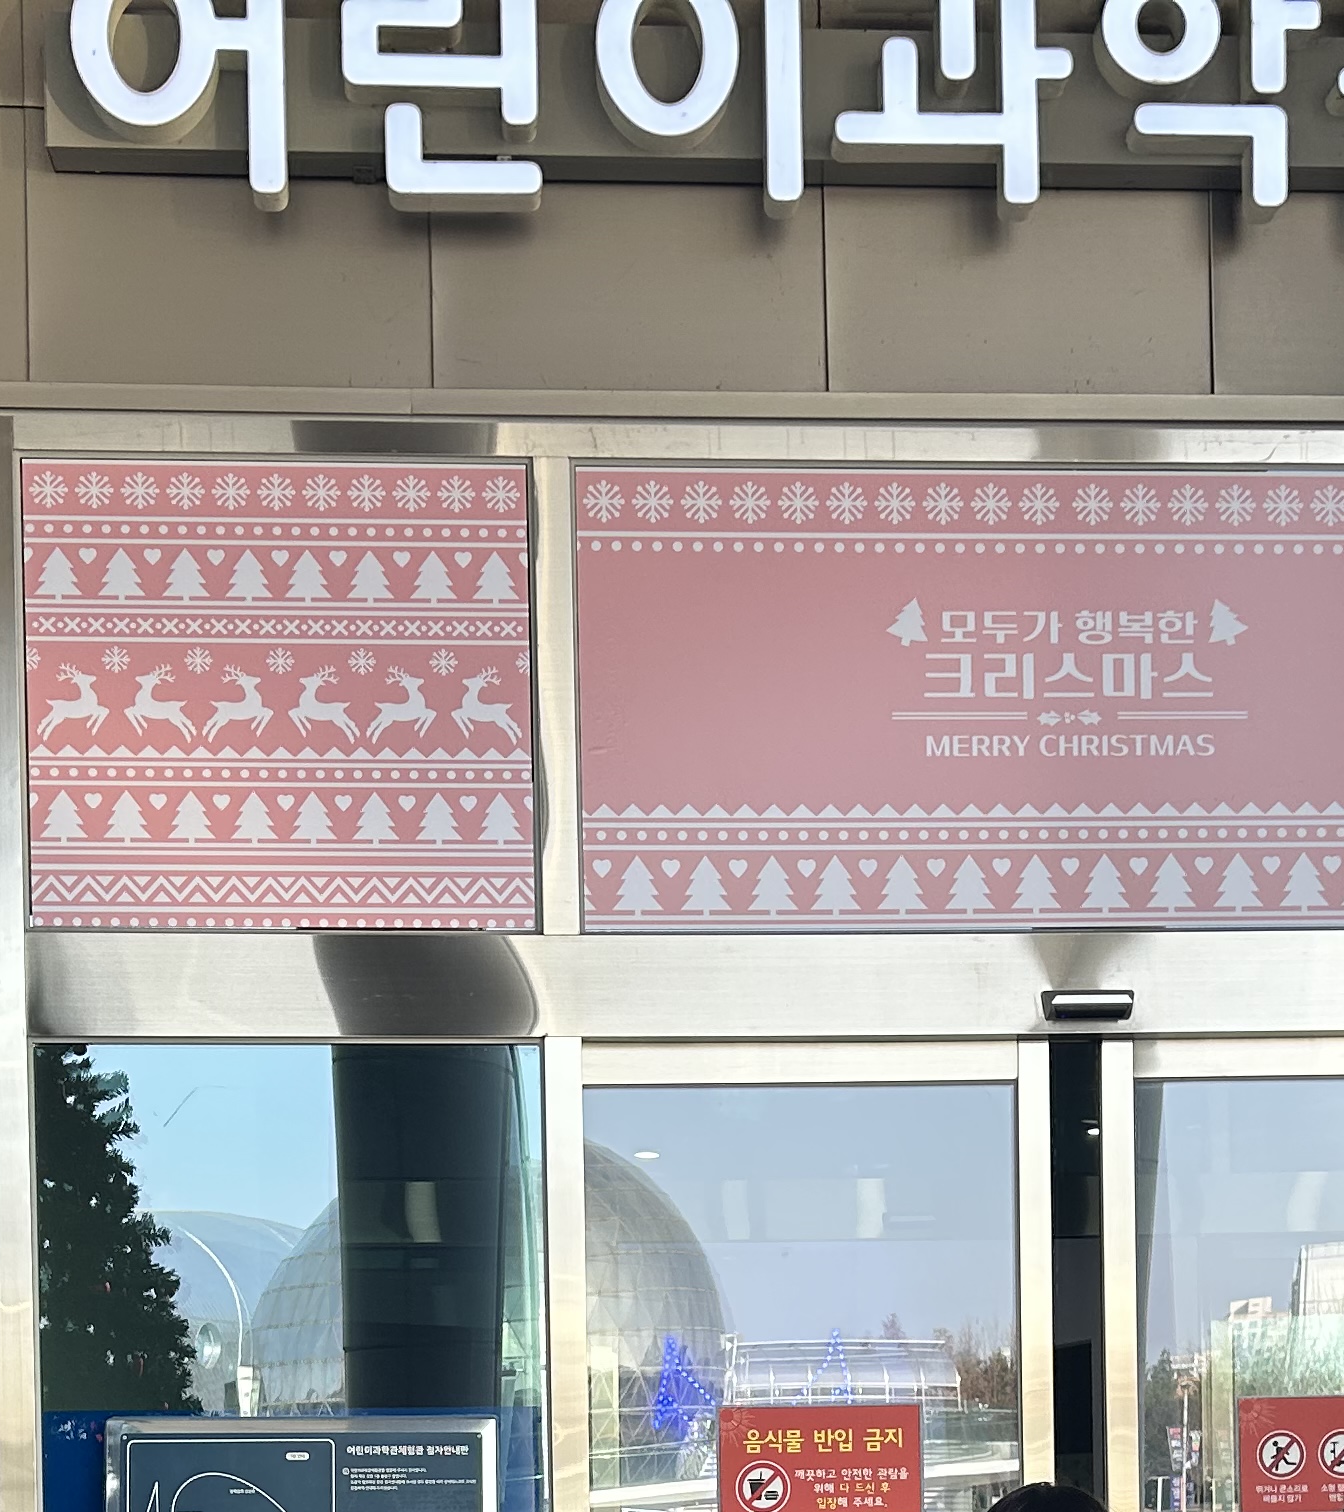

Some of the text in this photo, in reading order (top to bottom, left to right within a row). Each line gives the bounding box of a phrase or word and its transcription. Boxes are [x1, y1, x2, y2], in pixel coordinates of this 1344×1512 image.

[940, 610, 1199, 645] 모두가 행복한
[923, 652, 1215, 700] 크리스마스
[925, 734, 1216, 757] MERRY CHRISTMAS
[742, 1427, 904, 1454] 음식물 반입 금지
[794, 1467, 910, 1482] 깨끗하고 안전한 관람을
[813, 1481, 891, 1494] 위해 다 드신 후
[816, 1496, 888, 1510] 입장해 주세요.
